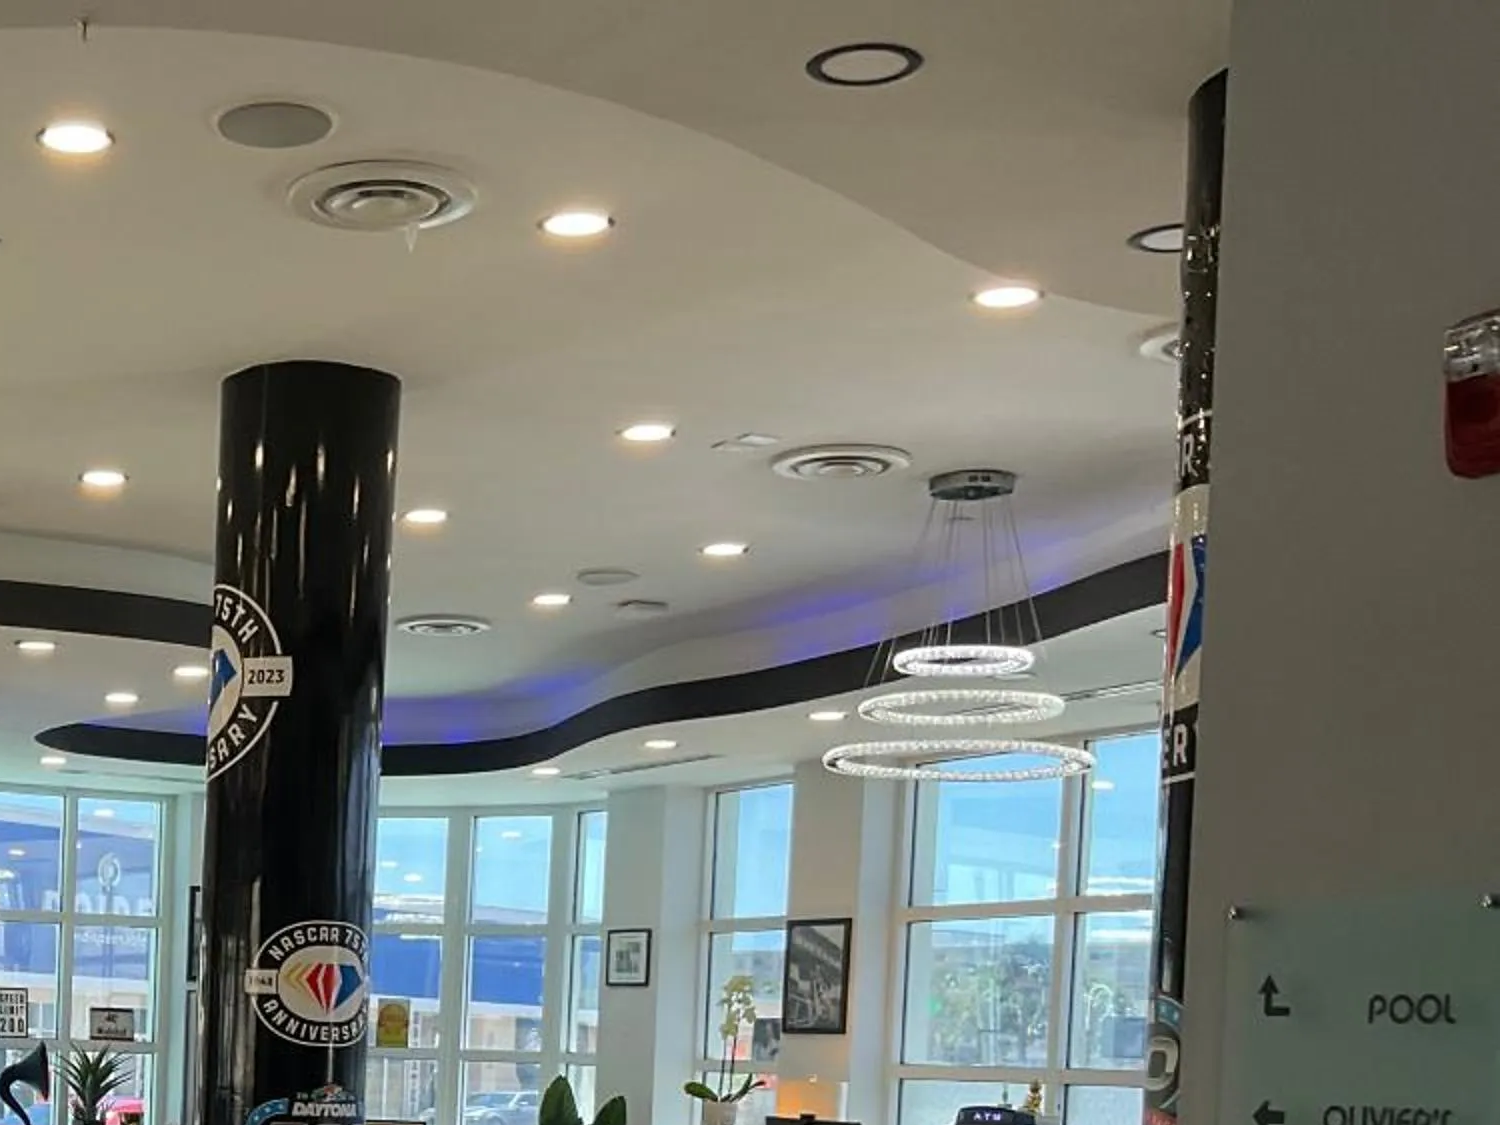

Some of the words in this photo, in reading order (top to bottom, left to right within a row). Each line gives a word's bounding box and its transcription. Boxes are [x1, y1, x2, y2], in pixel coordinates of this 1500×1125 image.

[248, 668, 285, 685] 2023
[268, 926, 339, 961] NASCAR
[1367, 994, 1457, 1025] POOL
[0, 1017, 25, 1033] 200
[972, 1111, 1002, 1121] ATM
